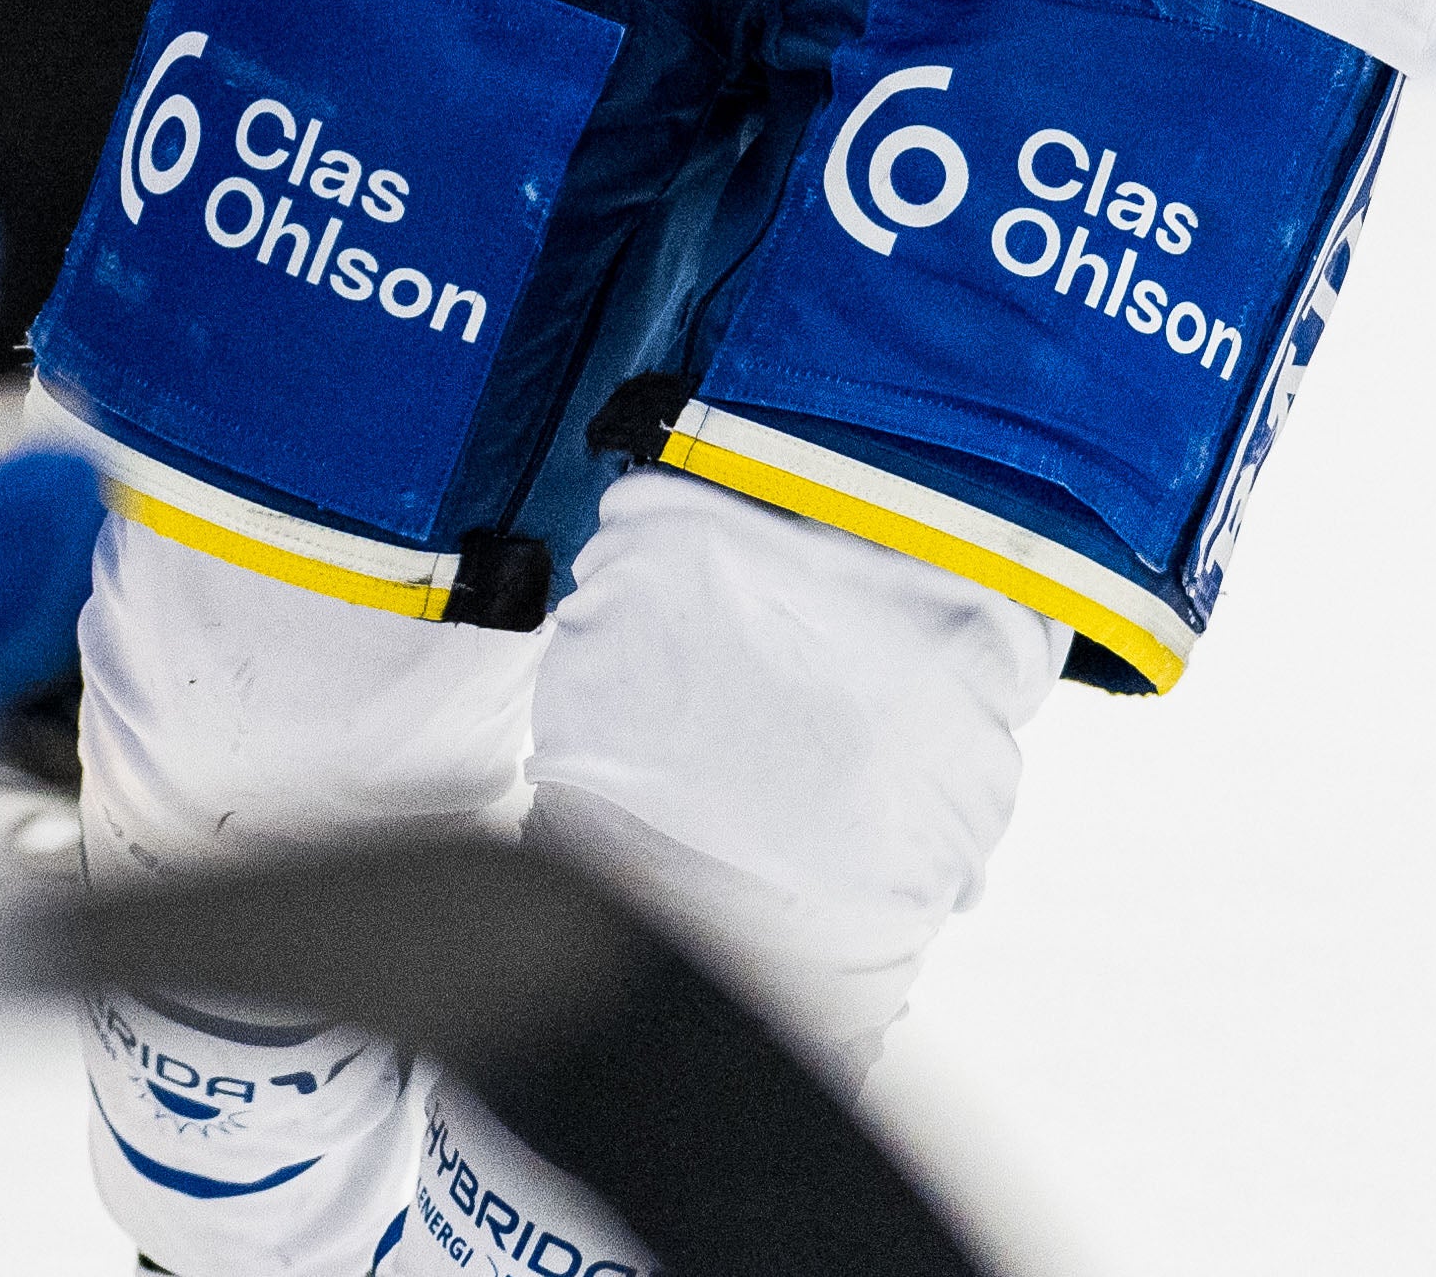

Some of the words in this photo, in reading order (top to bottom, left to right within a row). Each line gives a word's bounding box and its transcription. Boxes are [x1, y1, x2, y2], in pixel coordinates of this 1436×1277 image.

[236, 98, 410, 223] Clas
[1018, 128, 1198, 255] Clas
[204, 177, 487, 344] Ohlson
[991, 207, 1243, 381] Ohlson
